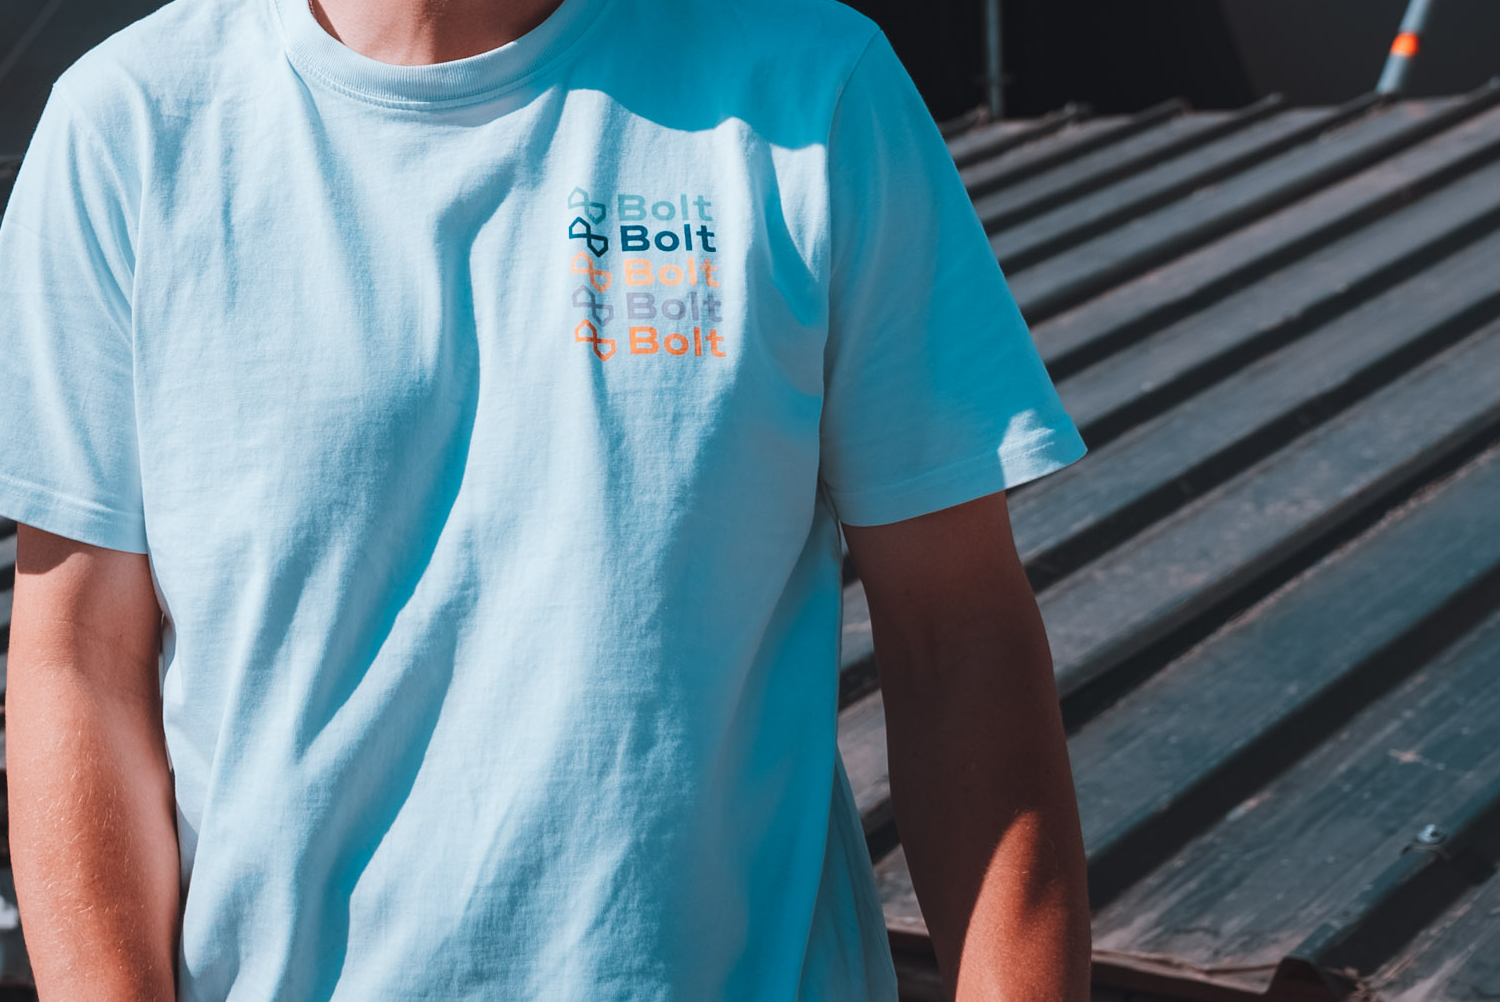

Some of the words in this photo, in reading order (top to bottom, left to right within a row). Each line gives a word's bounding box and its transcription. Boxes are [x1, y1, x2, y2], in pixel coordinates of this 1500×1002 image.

[617, 193, 713, 221] Bolt
[620, 223, 717, 252] Bolt
[623, 256, 721, 287] Bolt
[625, 291, 723, 322] Bolt
[628, 326, 727, 357] Bolt
